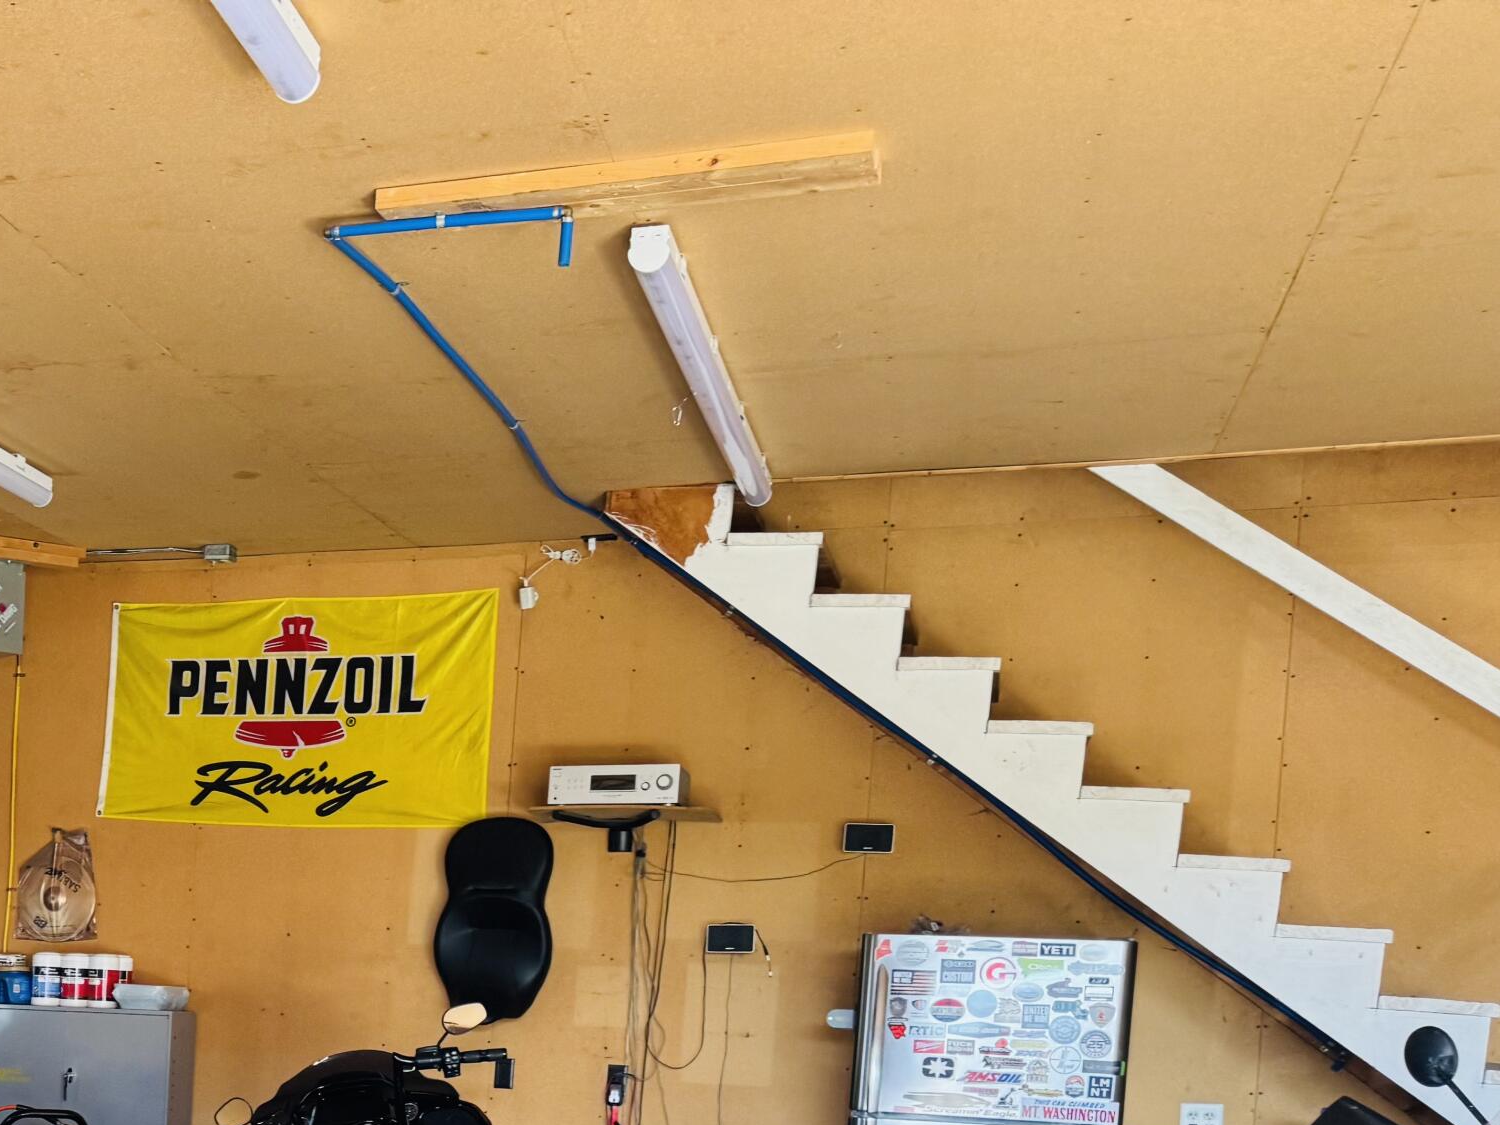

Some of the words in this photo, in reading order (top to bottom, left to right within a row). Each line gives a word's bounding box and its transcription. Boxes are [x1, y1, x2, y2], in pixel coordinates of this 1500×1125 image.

[166, 655, 430, 716] PENNZOIL
[190, 760, 389, 817] Racing
[1041, 945, 1075, 955] YETI
[908, 1025, 945, 1036] RTIC
[964, 1071, 1022, 1083] AMSOIL
[1091, 1077, 1110, 1088] LM
[1090, 1088, 1110, 1098] NT
[1043, 1106, 1116, 1123] WASHINGTON
